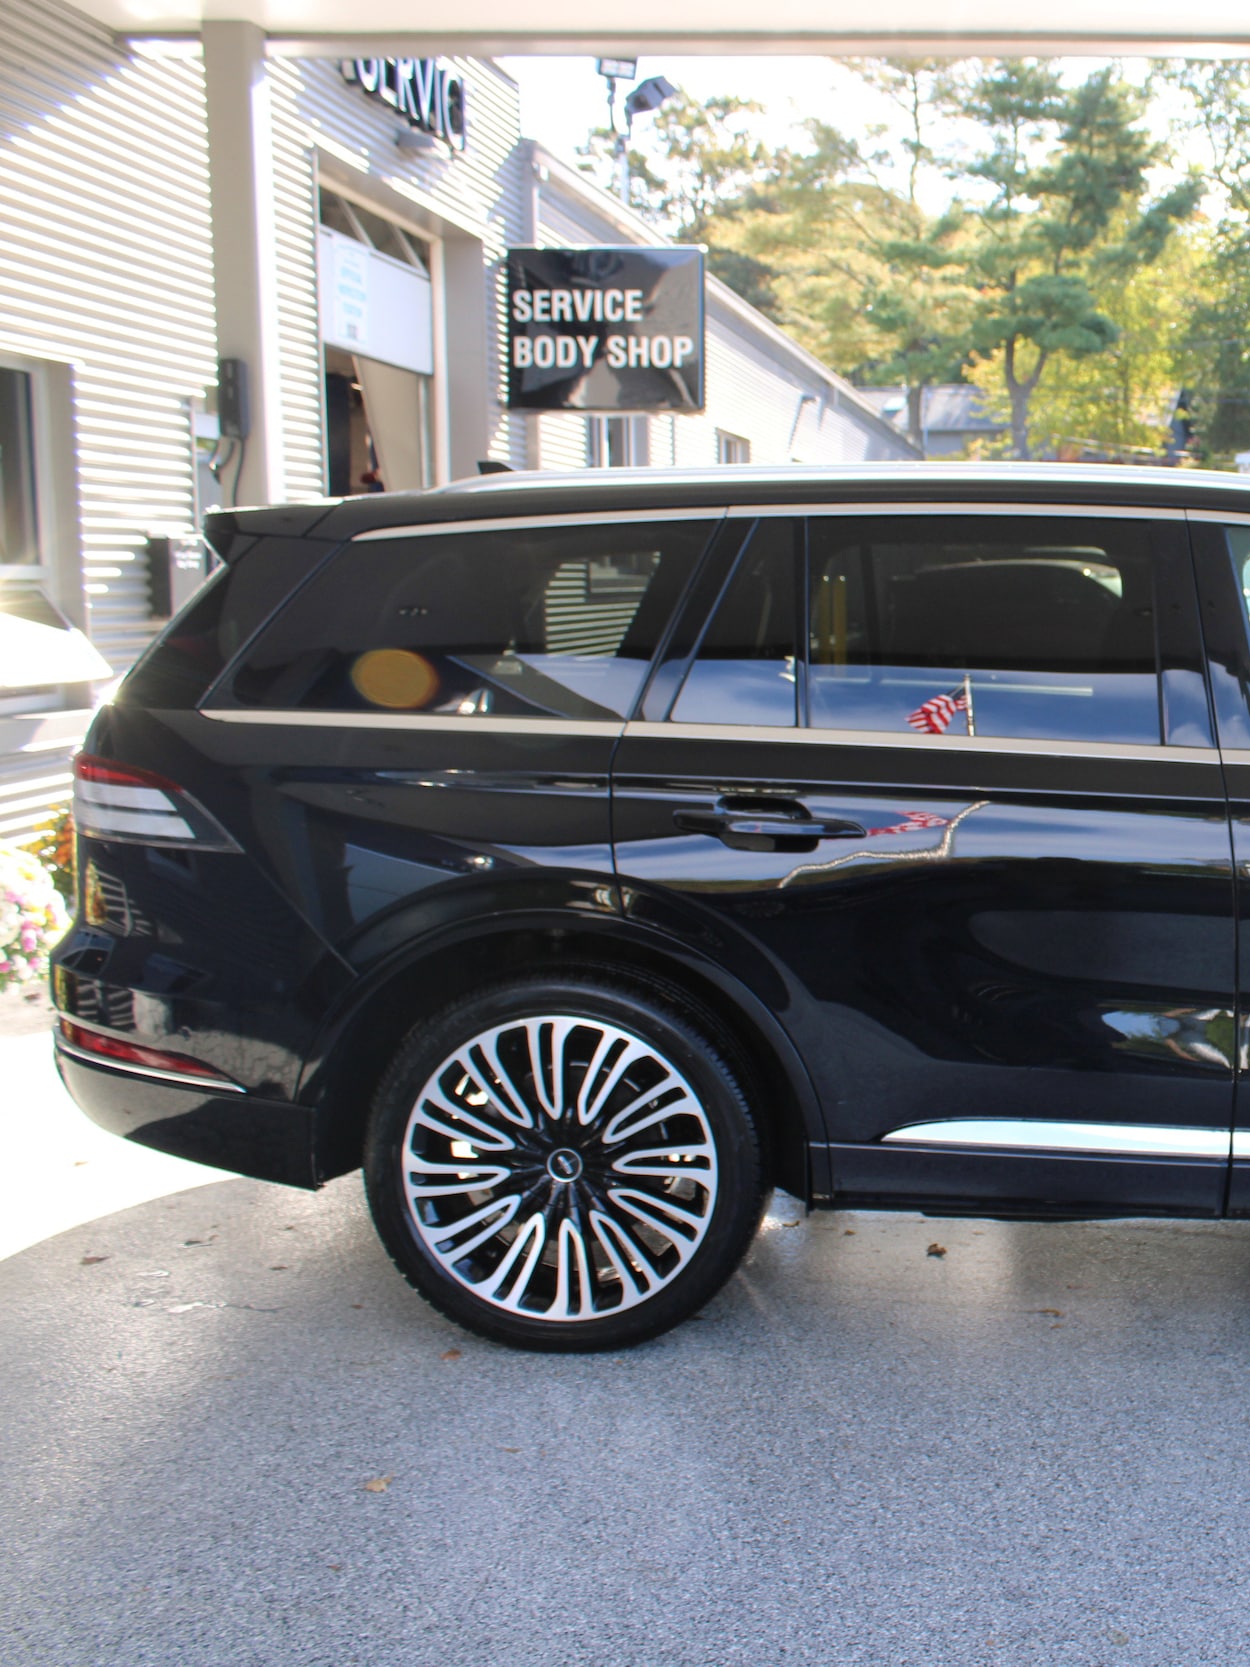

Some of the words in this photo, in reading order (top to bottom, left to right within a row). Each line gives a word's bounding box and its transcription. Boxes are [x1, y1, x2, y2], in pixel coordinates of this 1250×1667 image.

[512, 289, 644, 322] SERVICE
[513, 335, 599, 368] BODY
[606, 335, 694, 369] SHOP
